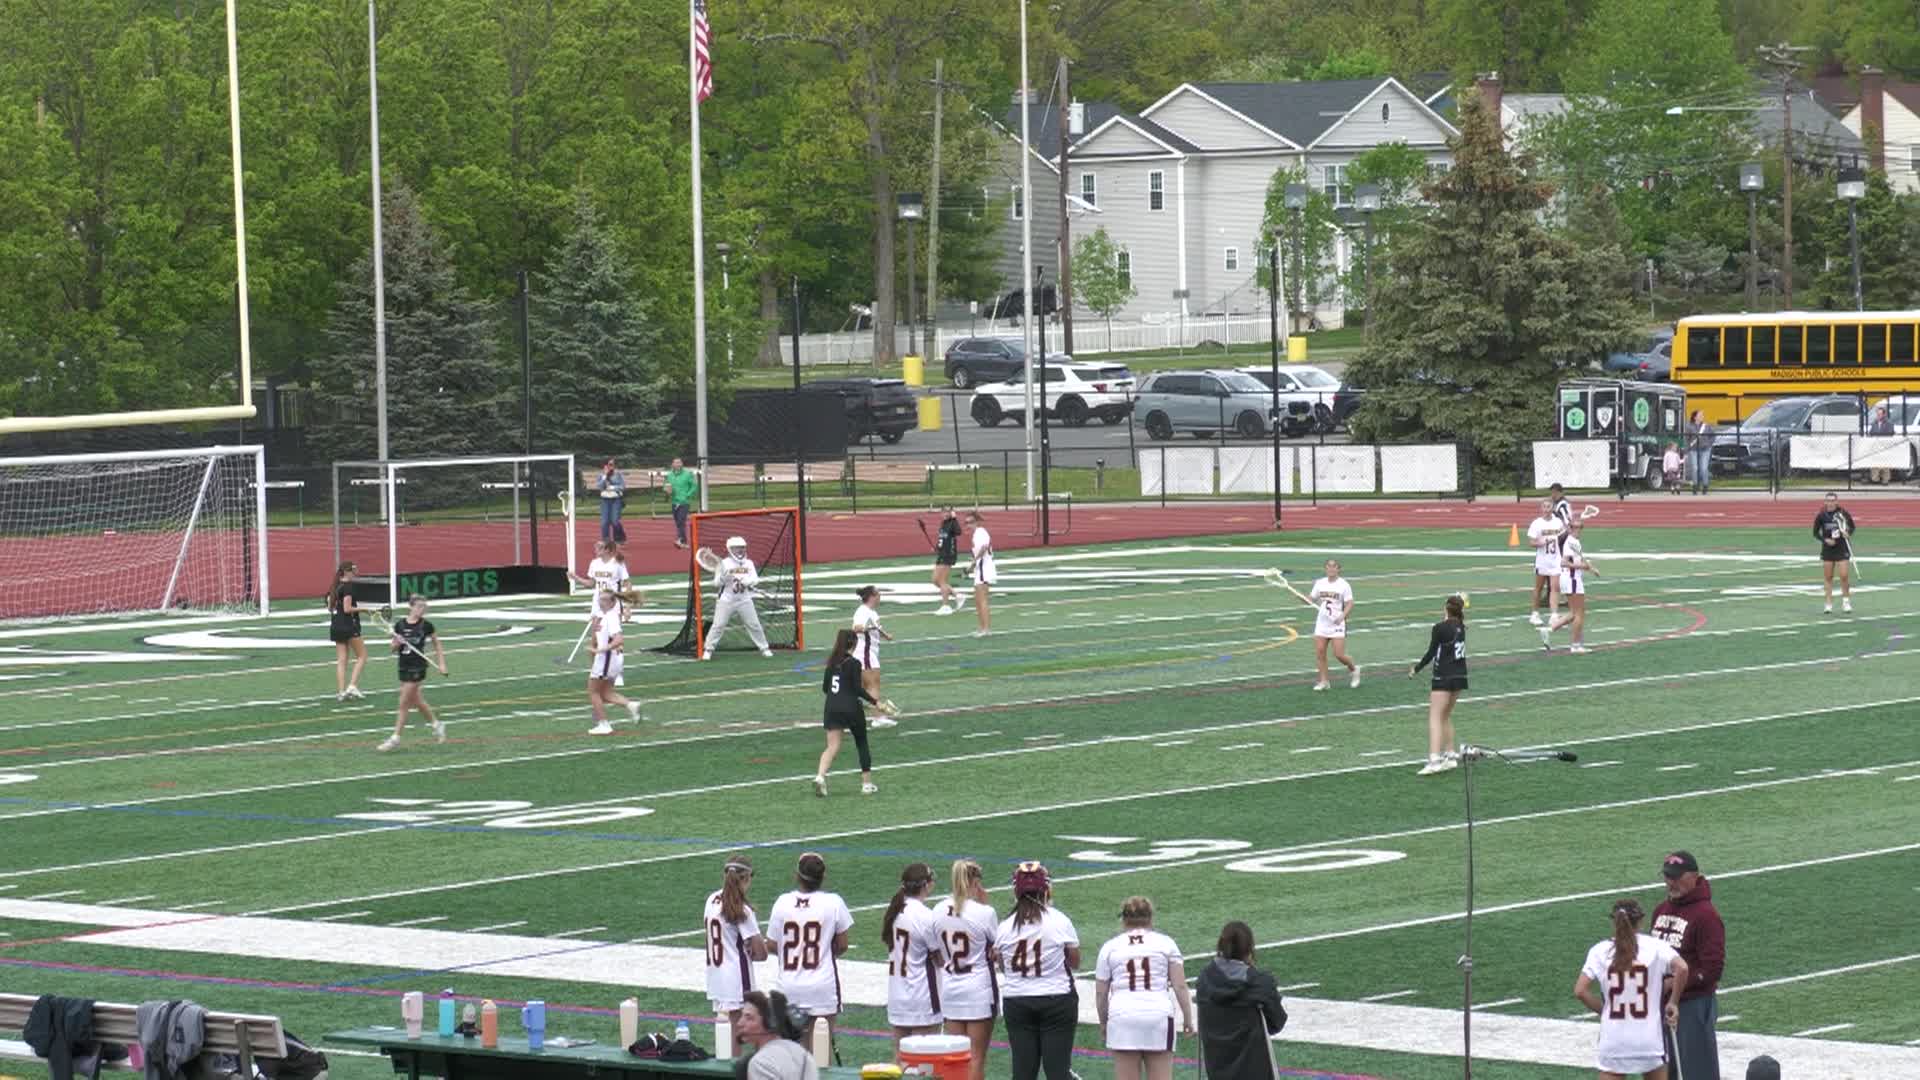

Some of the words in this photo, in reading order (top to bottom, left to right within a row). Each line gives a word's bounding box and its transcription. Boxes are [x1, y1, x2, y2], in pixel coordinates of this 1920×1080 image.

[1770, 368, 1803, 379] MADISON
[1804, 368, 1831, 378] PUBLIC
[1832, 367, 1866, 378] SCHOOLS
[1545, 538, 1557, 555] 13
[400, 568, 499, 601] NCERS
[831, 675, 841, 694] 5
[794, 897, 810, 908] M
[783, 921, 822, 971] 28
[1127, 935, 1145, 945] M
[1011, 939, 1042, 979] 41
[1126, 957, 1150, 992] 11
[1607, 963, 1650, 1020] 23
